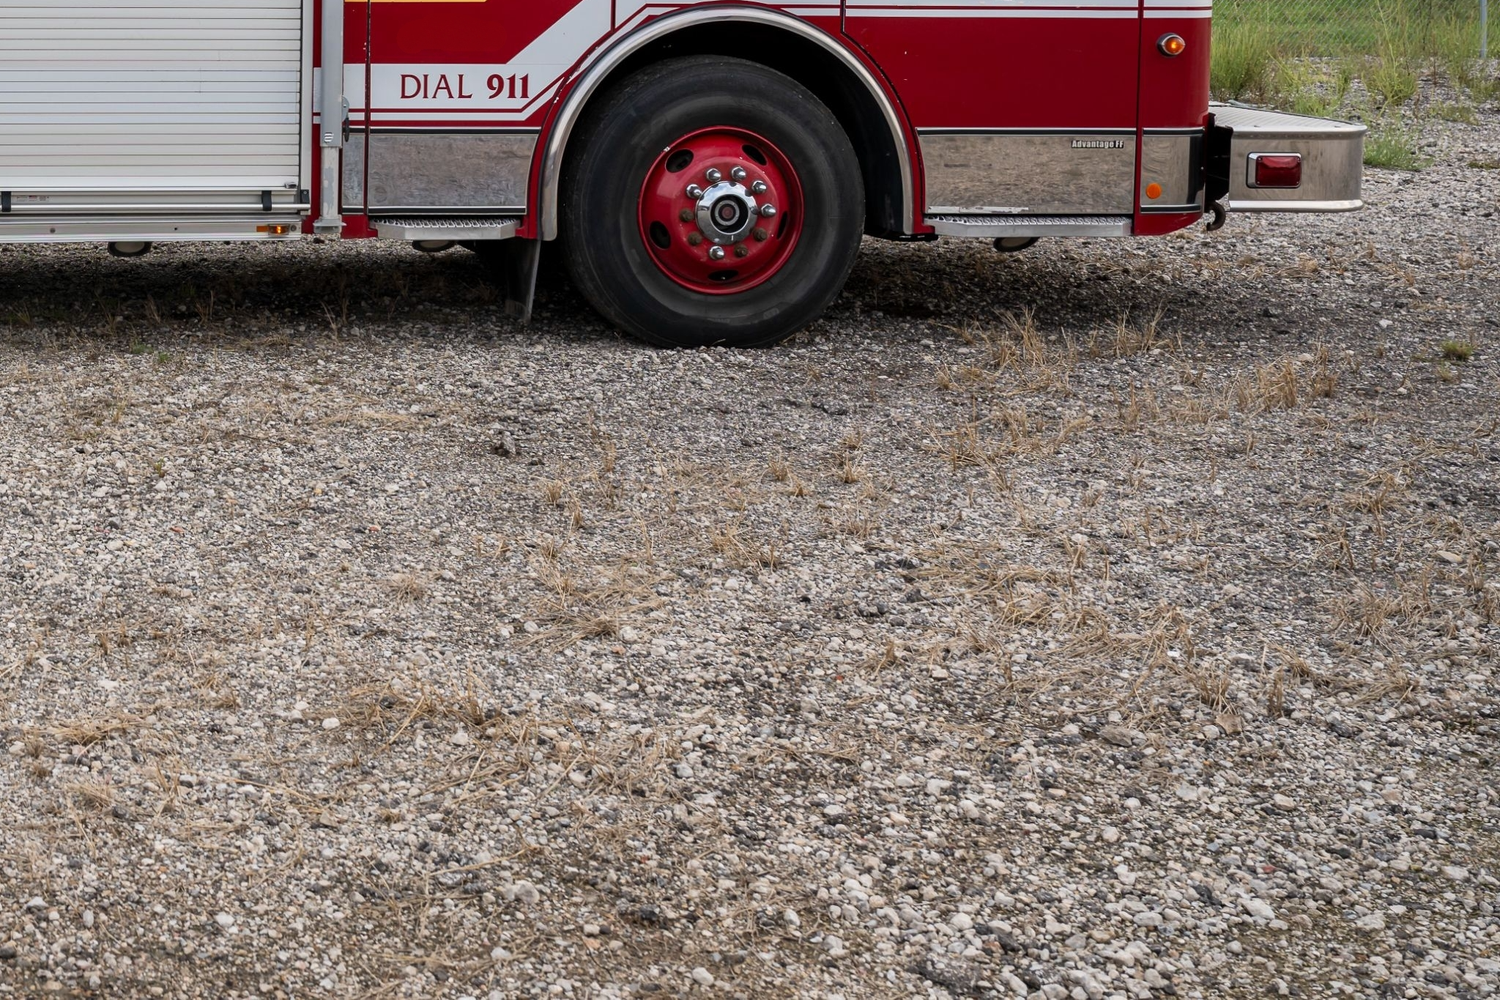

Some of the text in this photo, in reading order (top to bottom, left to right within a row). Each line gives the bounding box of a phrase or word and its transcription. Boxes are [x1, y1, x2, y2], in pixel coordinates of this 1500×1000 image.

[400, 73, 530, 99] DIAL 911
[1072, 140, 1124, 149] Advantage FF
